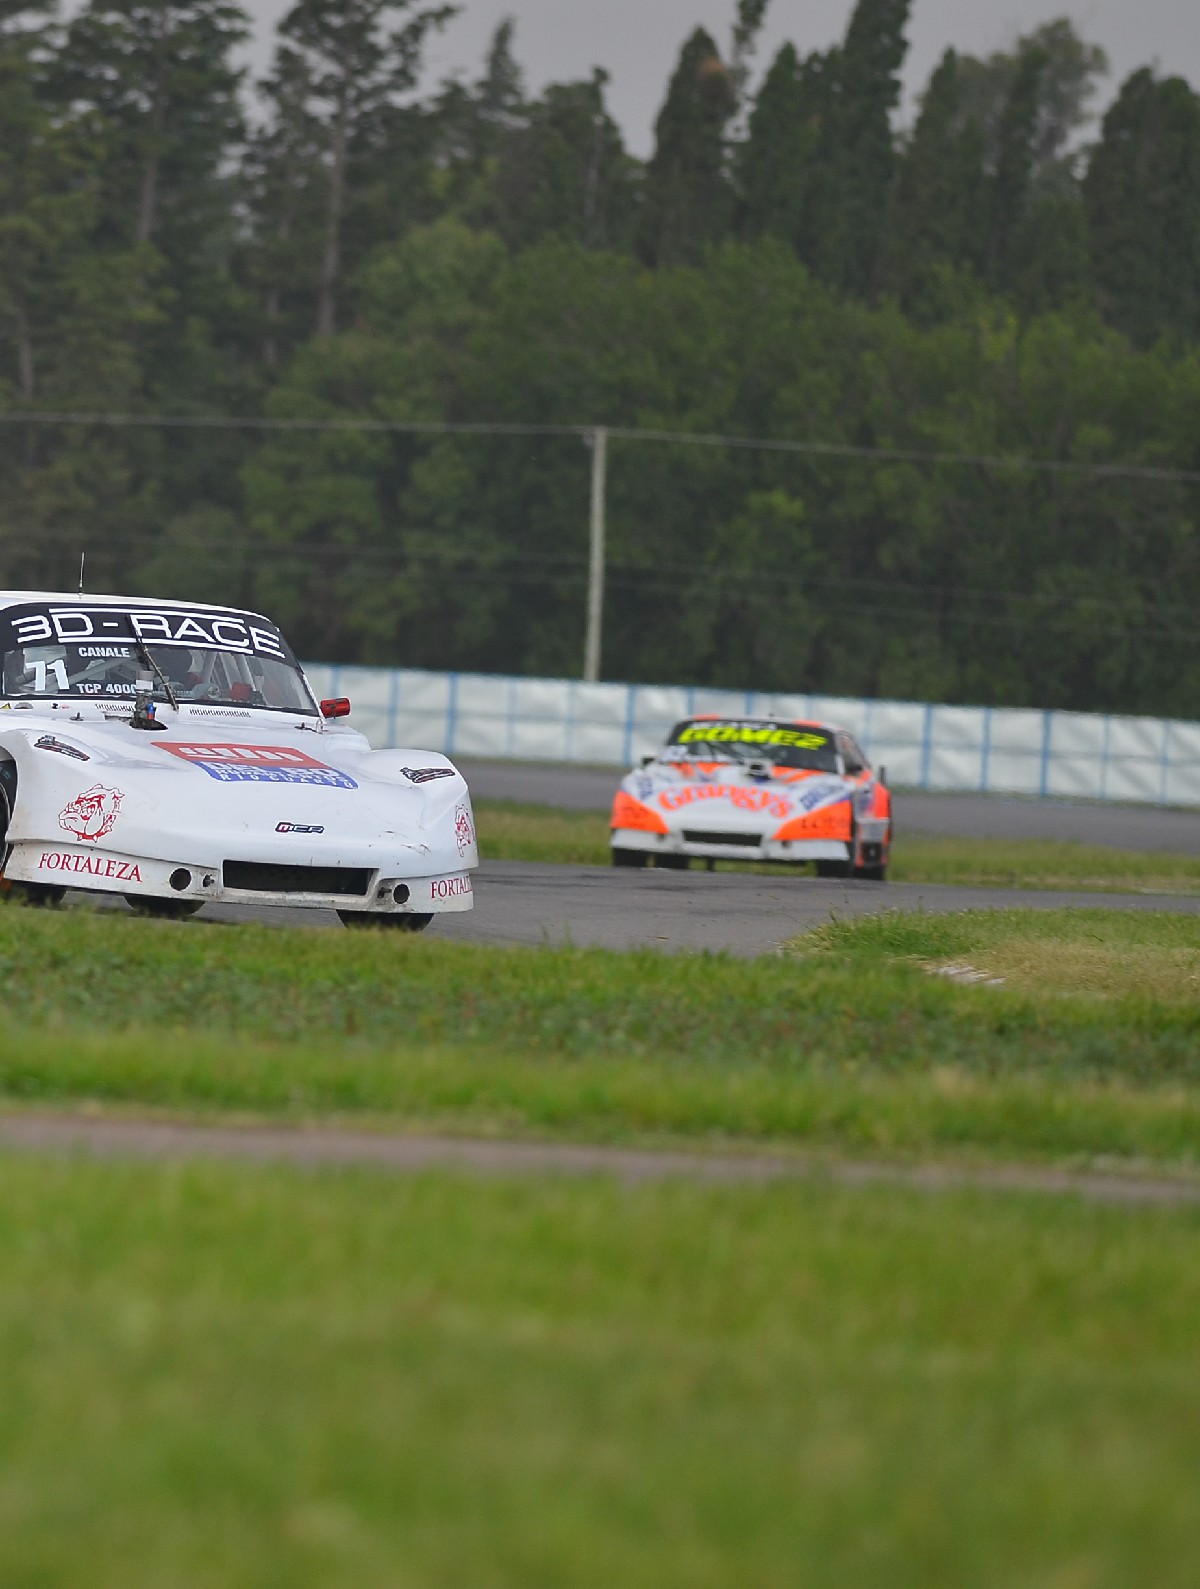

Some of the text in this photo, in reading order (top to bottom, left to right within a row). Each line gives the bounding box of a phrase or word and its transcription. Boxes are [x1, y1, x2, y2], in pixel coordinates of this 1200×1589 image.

[78, 647, 131, 658] CANALE
[26, 660, 70, 692] 71
[76, 684, 102, 694] TCP
[38, 853, 142, 882] FORTALEZA
